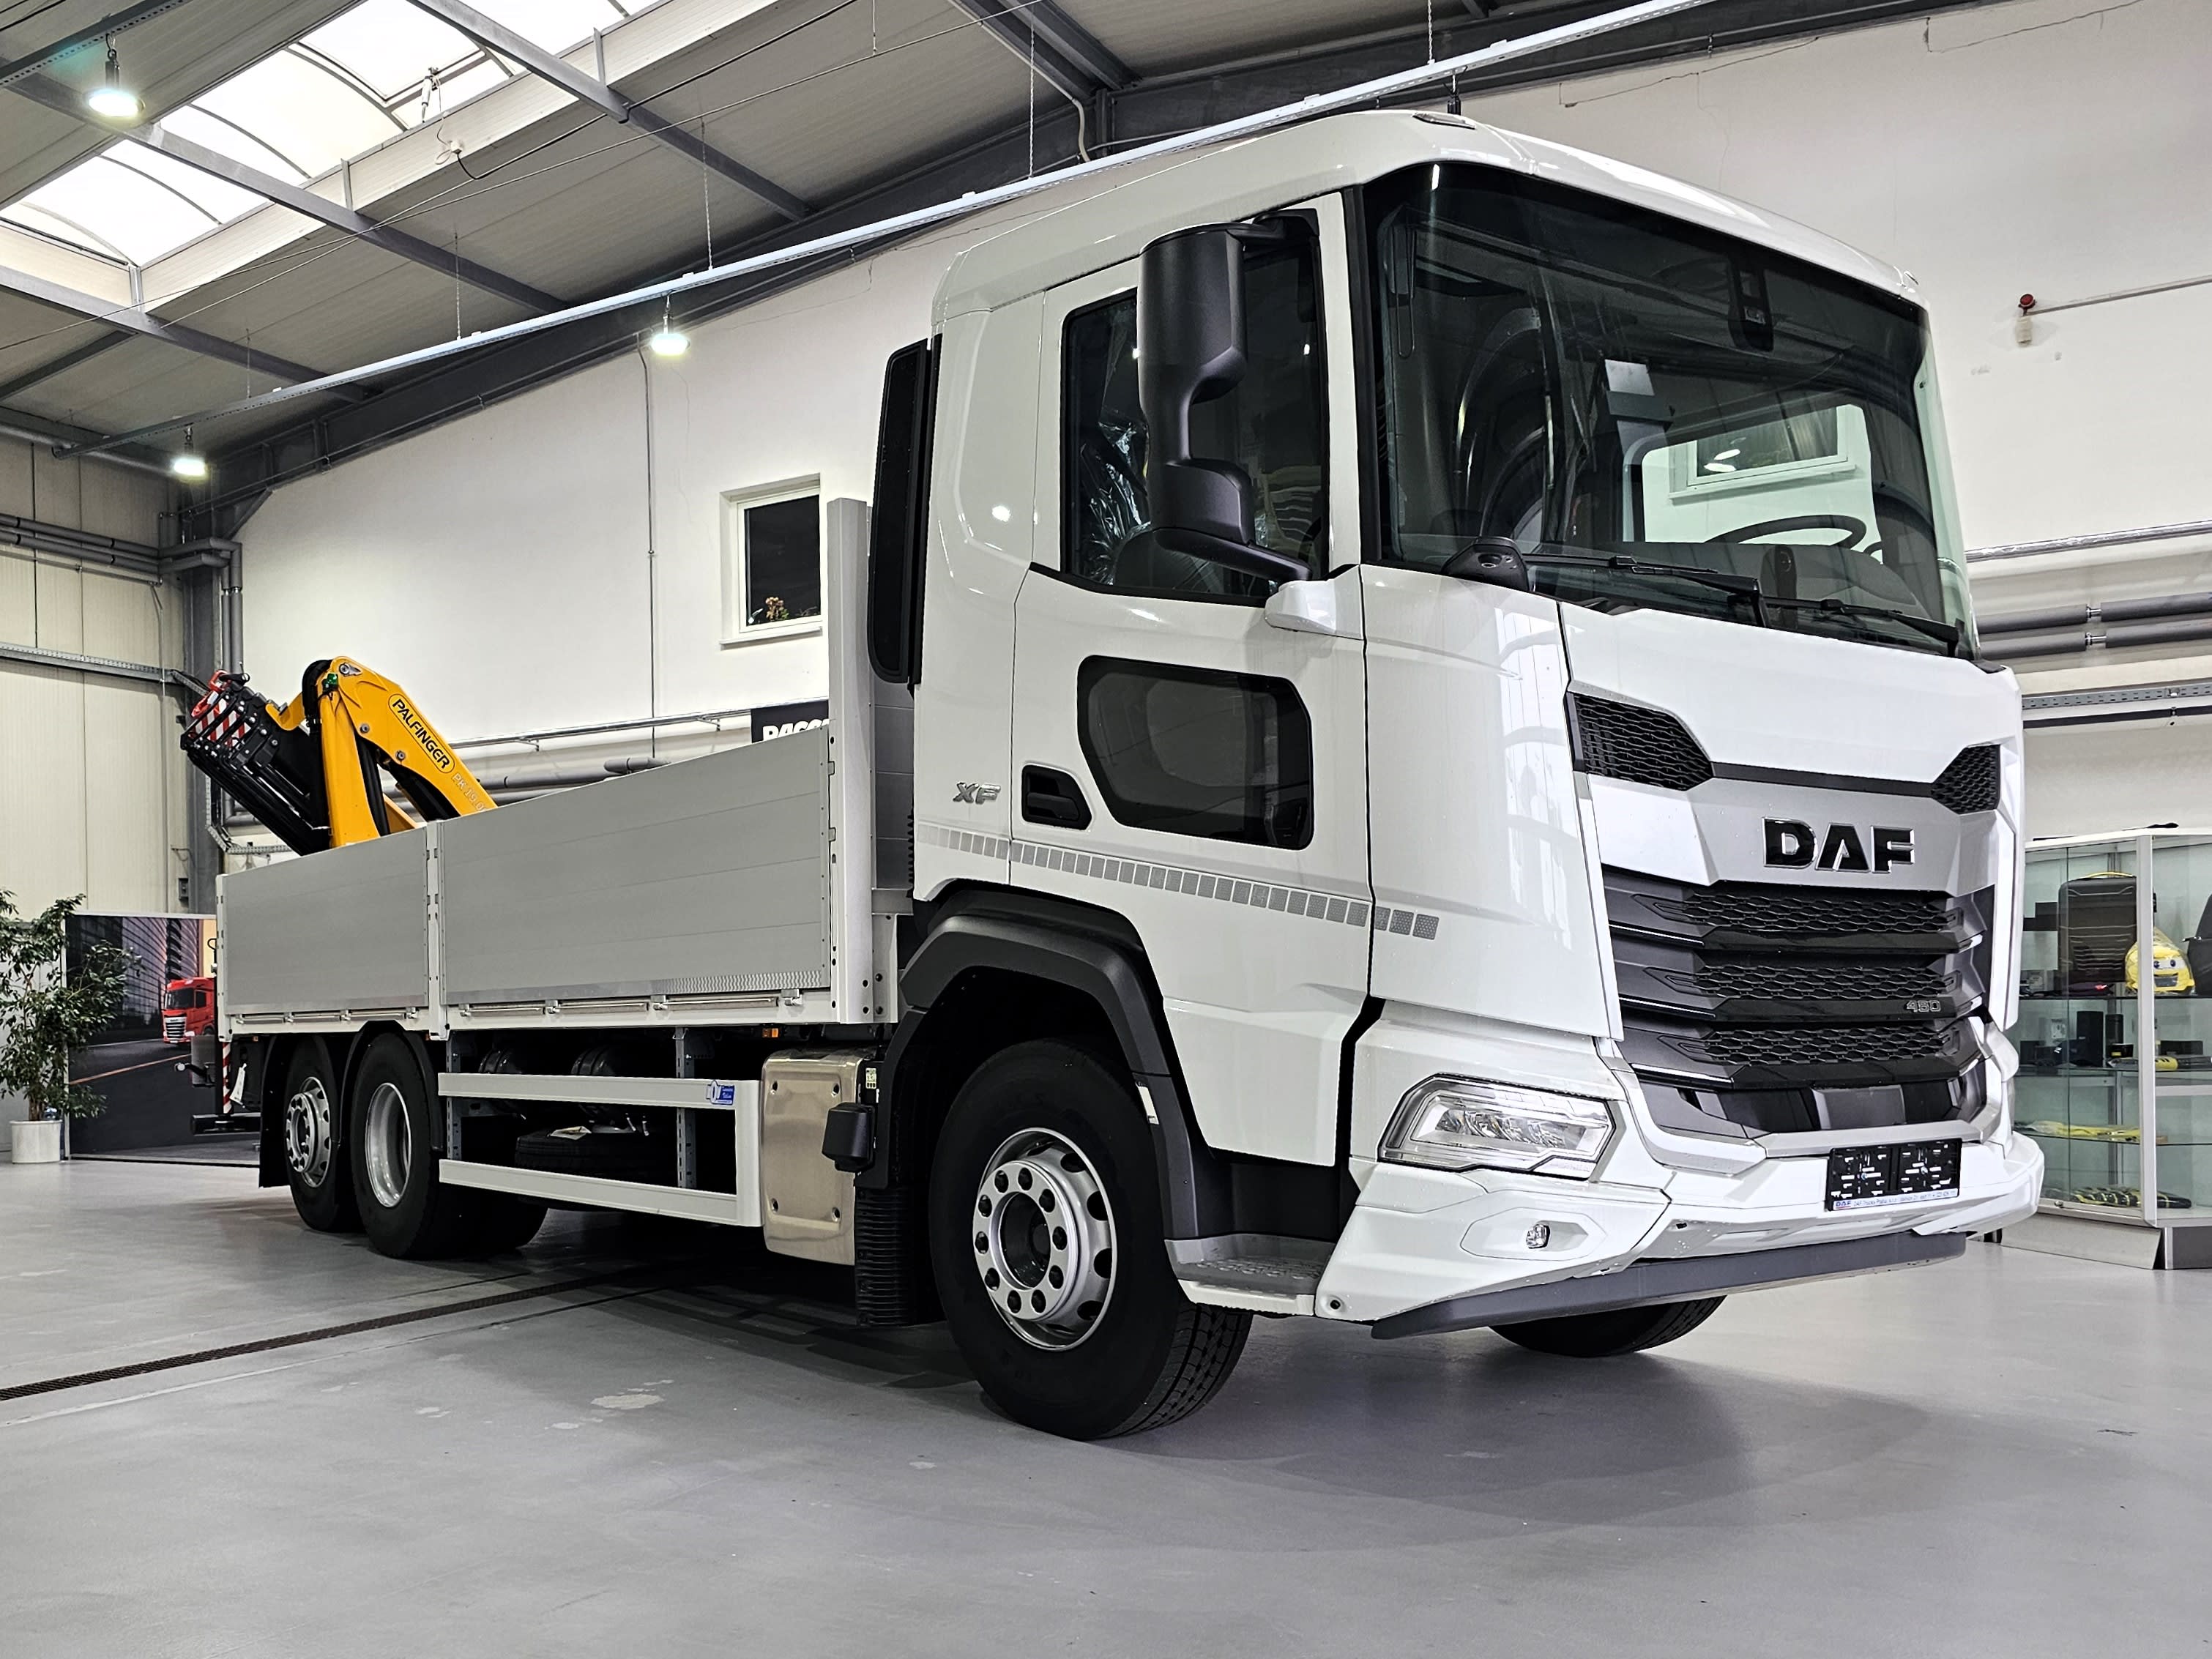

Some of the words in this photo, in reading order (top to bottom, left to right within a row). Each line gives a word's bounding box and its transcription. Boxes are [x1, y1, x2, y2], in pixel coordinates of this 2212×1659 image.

[392, 698, 450, 769] PALFINGER
[451, 772, 467, 791] PK
[463, 788, 487, 812] 19.0
[953, 782, 1001, 805] XF
[1763, 816, 1915, 874] DAF
[1906, 999, 1941, 1013] 480
